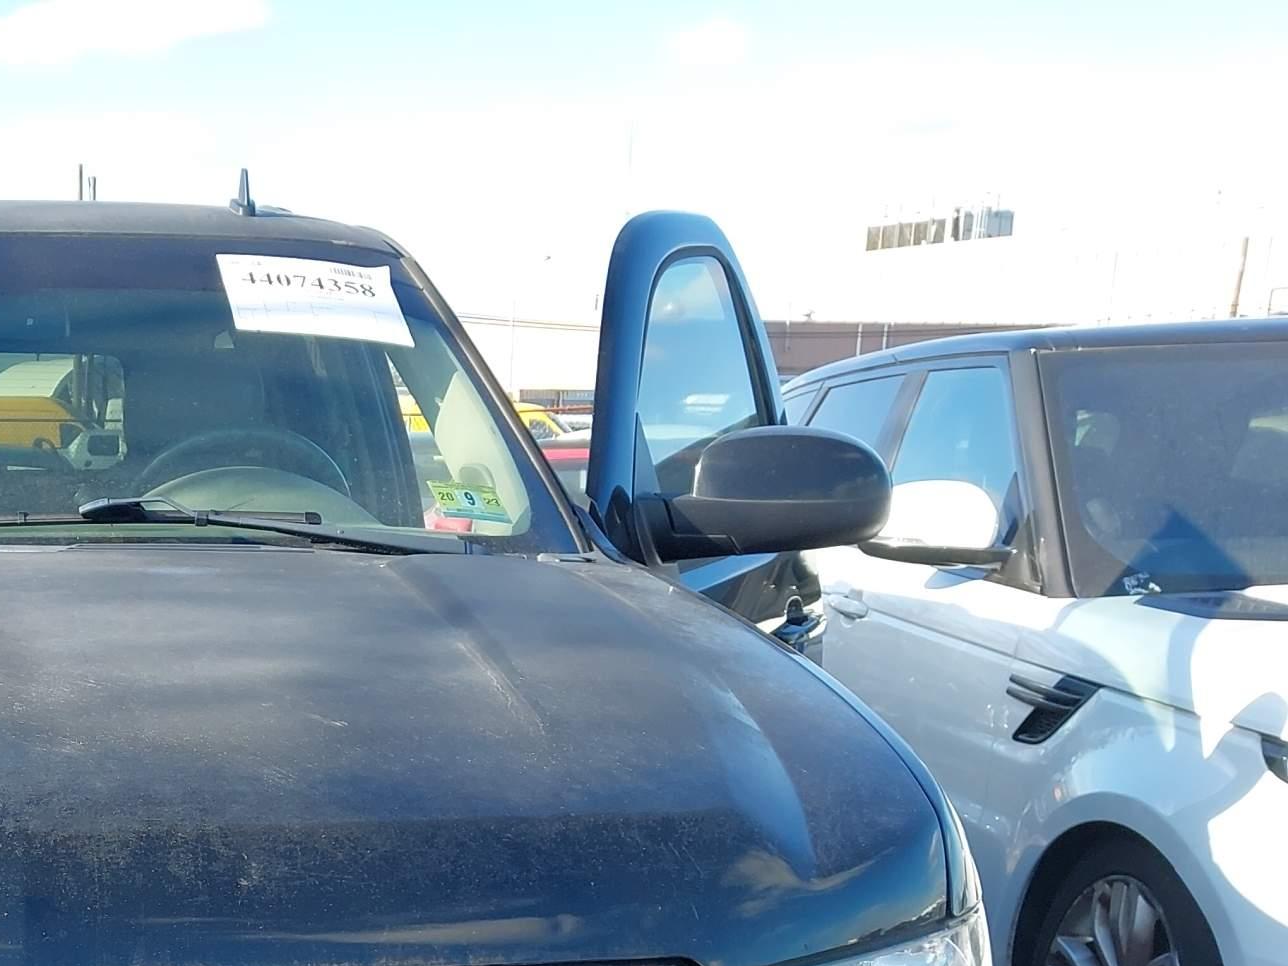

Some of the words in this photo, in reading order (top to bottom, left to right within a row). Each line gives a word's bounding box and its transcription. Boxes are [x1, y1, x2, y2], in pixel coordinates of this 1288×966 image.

[241, 271, 377, 298] 44074358
[438, 491, 455, 502] 20
[463, 491, 476, 506] 9
